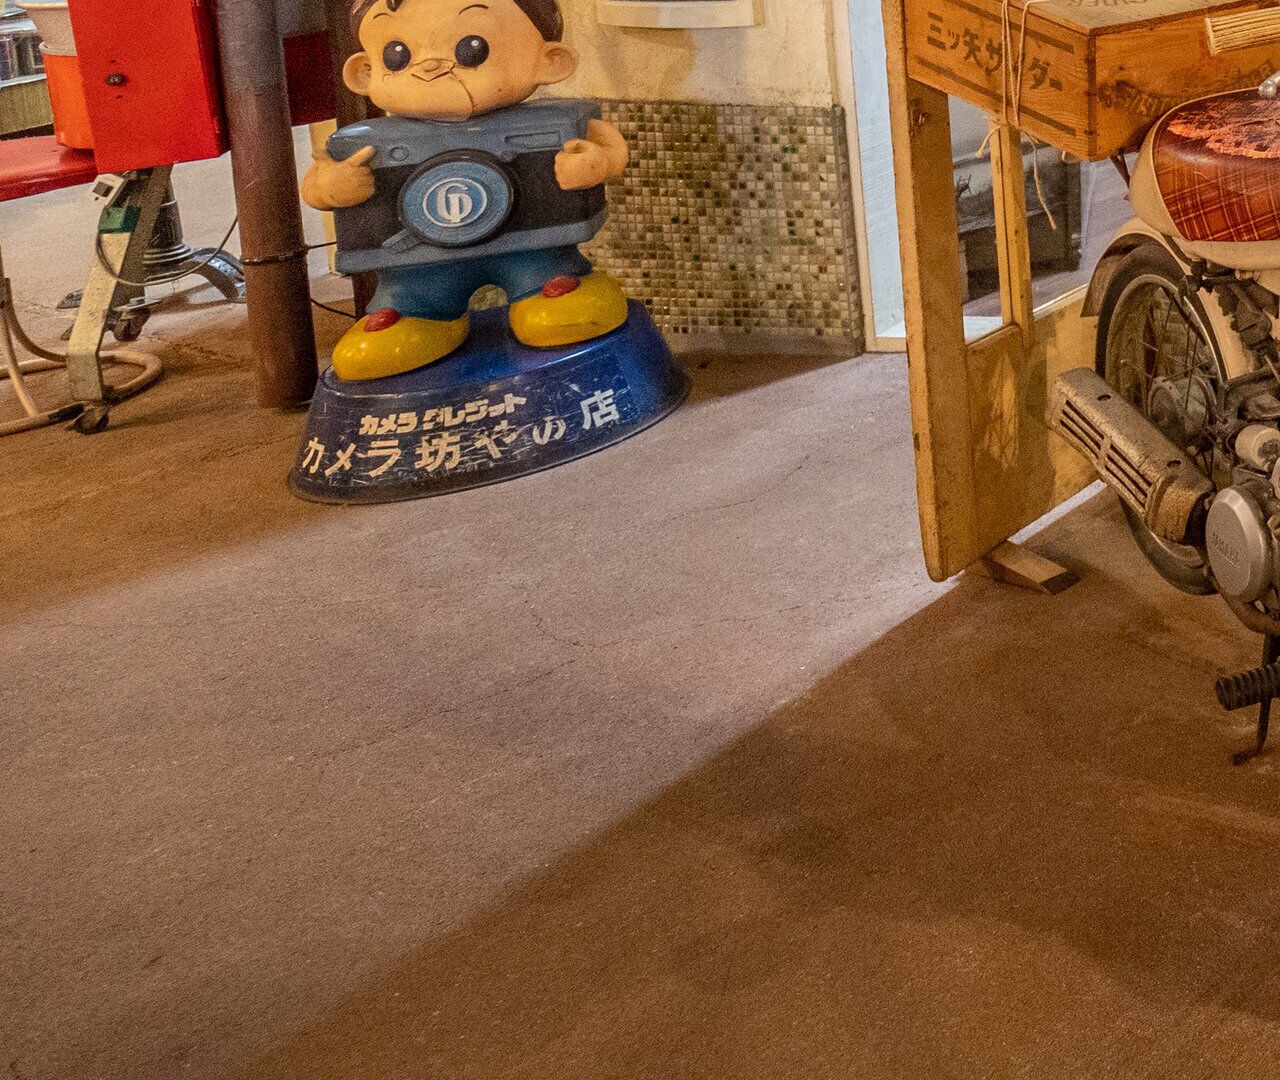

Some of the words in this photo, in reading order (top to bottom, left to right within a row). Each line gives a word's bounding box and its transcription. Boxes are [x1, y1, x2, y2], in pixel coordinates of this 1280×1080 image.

[302, 388, 621, 478] カメラ坊やの店
